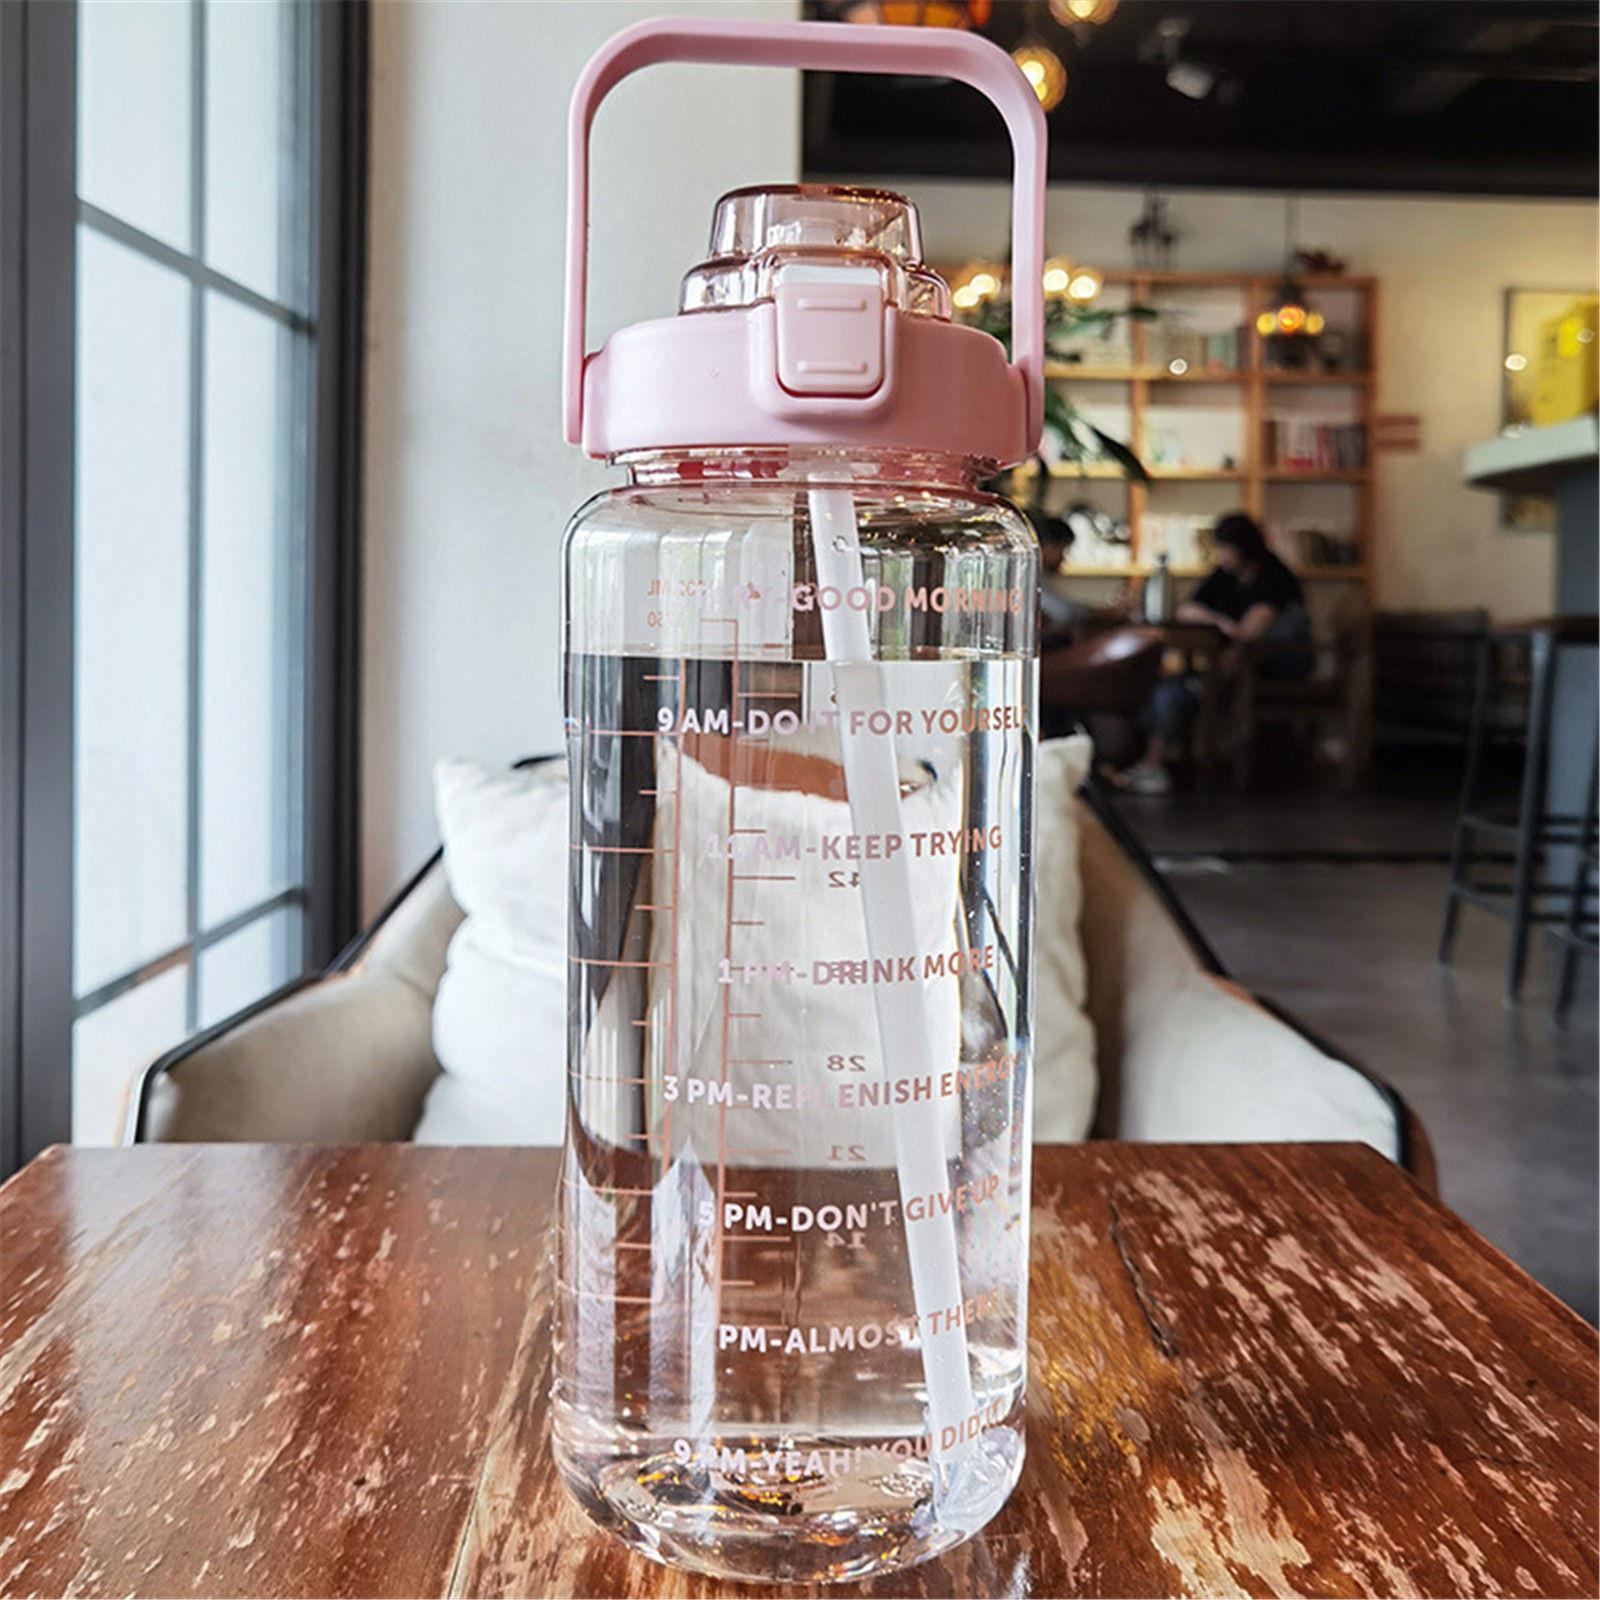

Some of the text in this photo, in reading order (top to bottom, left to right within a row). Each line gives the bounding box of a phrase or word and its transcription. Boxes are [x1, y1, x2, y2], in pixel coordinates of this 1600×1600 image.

[657, 704, 1027, 736] 9 AM-DO IT FOR YOURSELF
[752, 834, 902, 860] AM-KEEP
[910, 825, 1002, 856] TRYING
[718, 958, 733, 984] 1
[744, 957, 916, 985] PM-DRINK
[924, 945, 994, 979] MORE
[663, 1074, 679, 1101] 3
[687, 1075, 932, 1110] PM-REPLENISH
[699, 1174, 999, 1231] 5 PM-DON'T GIVE UP
[719, 1315, 920, 1355] PM-ALMOST
[673, 1438, 692, 1466] 9
[870, 1432, 932, 1464] YOU
[940, 1413, 980, 1451] DID
